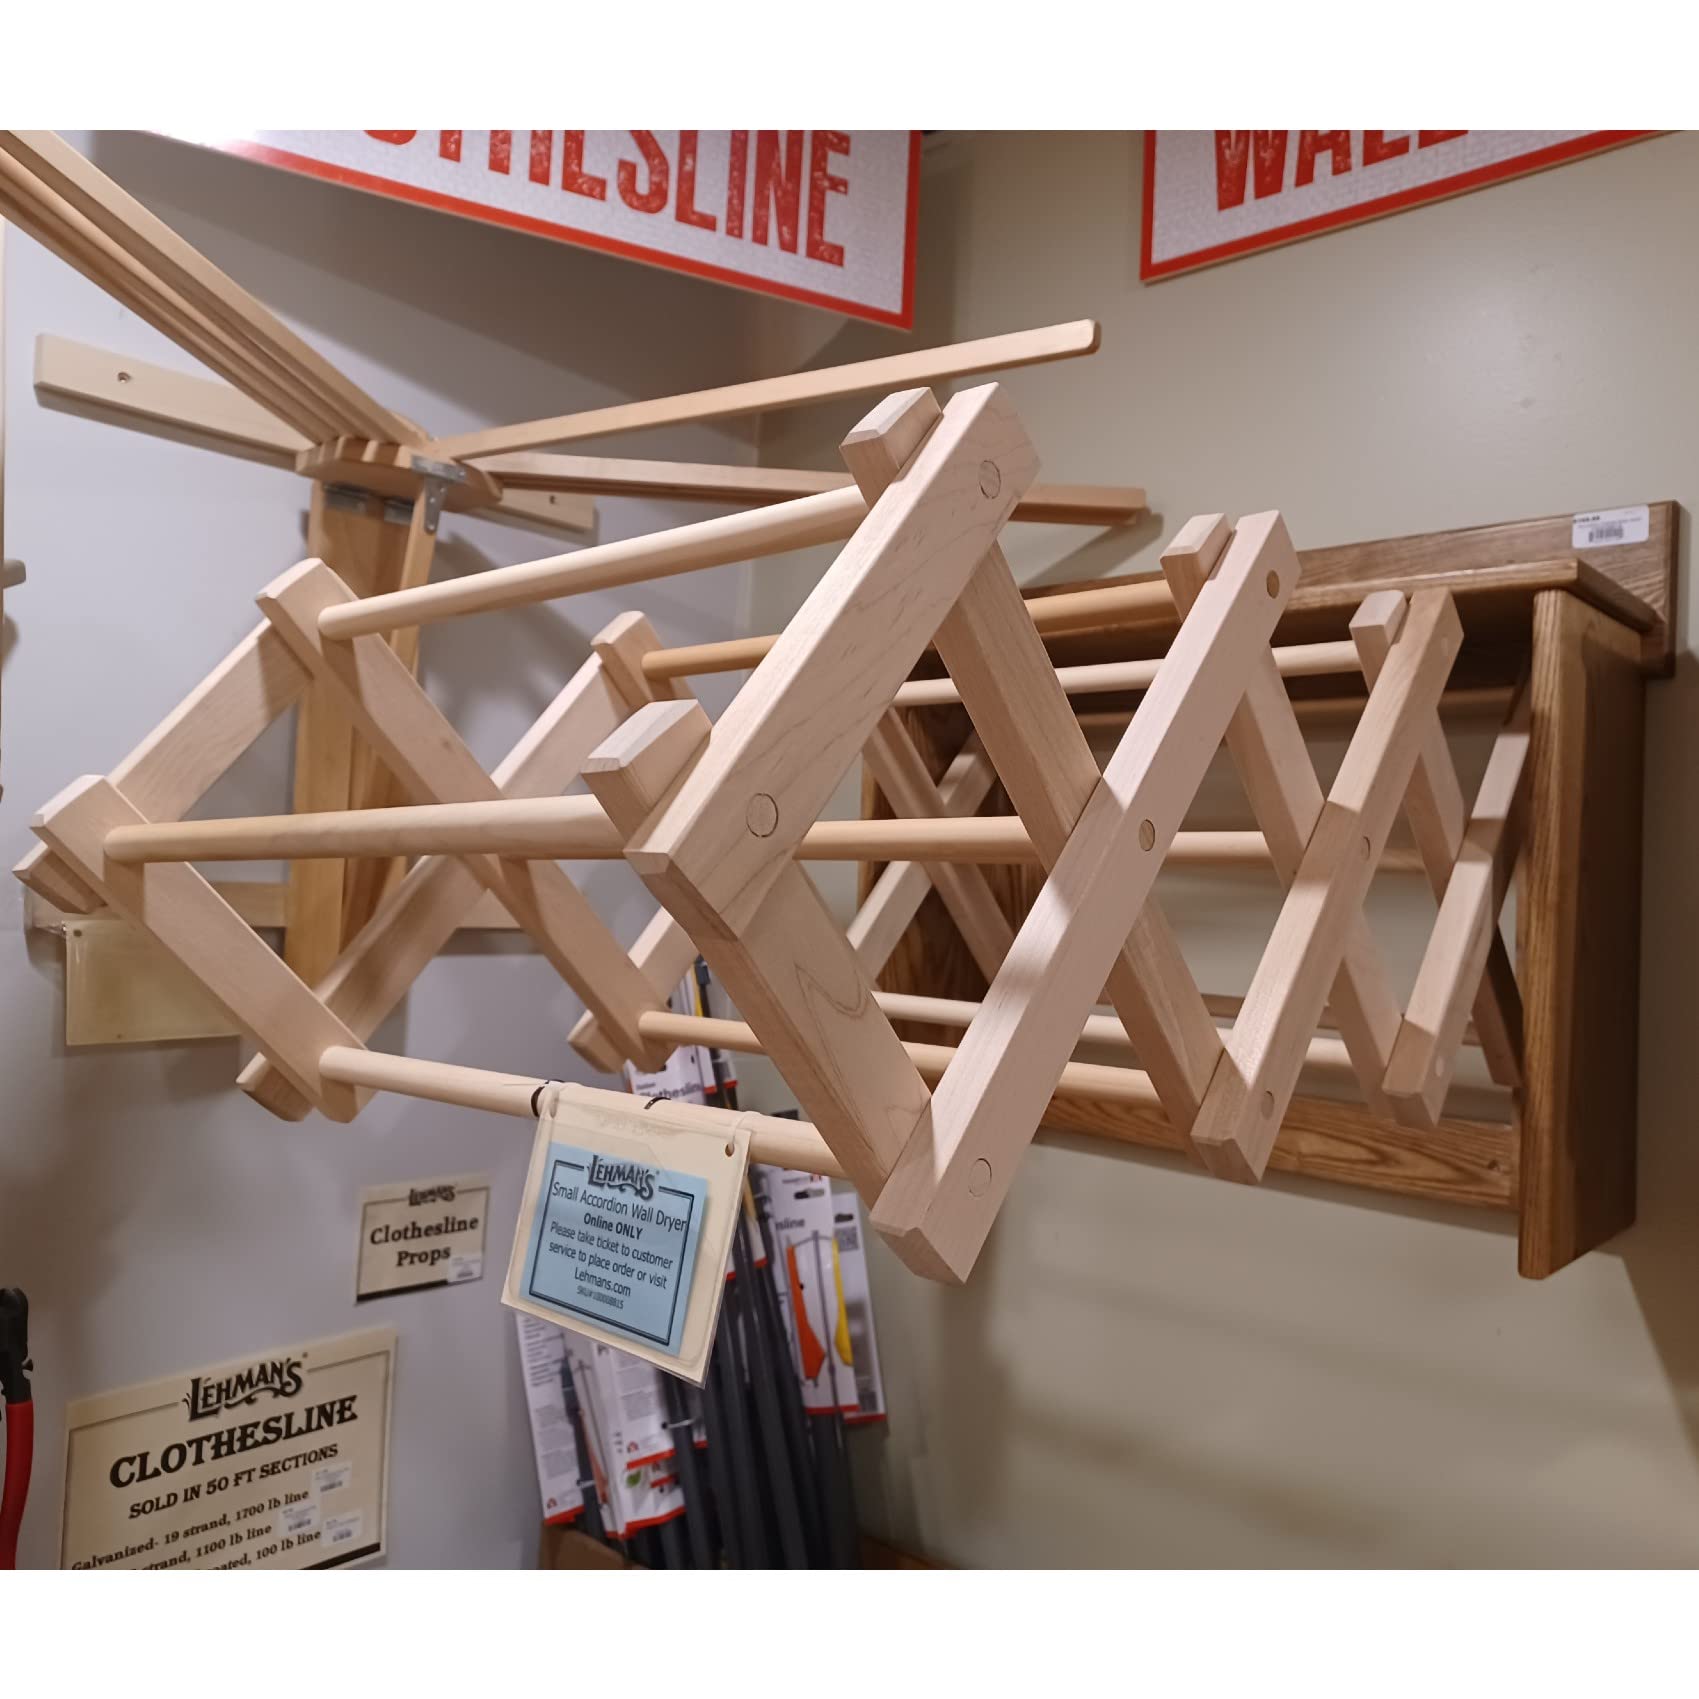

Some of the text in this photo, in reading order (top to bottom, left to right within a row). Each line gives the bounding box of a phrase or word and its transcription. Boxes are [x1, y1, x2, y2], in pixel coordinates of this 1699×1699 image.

[362, 130, 851, 267] SLINE
[587, 1155, 656, 1200] LEHMAN'S
[370, 1216, 479, 1245] Clothesline
[552, 1181, 687, 1232] Small Accordion Wall Dryer
[584, 1212, 643, 1240] Online ONLY
[396, 1246, 451, 1267] Props
[549, 1241, 667, 1289] service to place order or visit
[550, 1221, 673, 1269] Please take ticket to customer
[575, 1266, 631, 1297] Lehmans.com
[182, 1358, 303, 1421] LEHMAN'S
[109, 1395, 358, 1488] CLOTHESLINE
[128, 1492, 178, 1519] SOLD
[182, 1484, 202, 1503] IN
[206, 1476, 229, 1495] 50
[233, 1468, 256, 1487] FT
[258, 1443, 339, 1479] SECTIONS
[164, 1531, 180, 1545] 19
[182, 1513, 231, 1539] strand,
[236, 1503, 265, 1521] 1700
[268, 1497, 281, 1510] lb
[284, 1491, 309, 1505] line
[196, 1539, 226, 1557] 1100
[229, 1533, 243, 1547] lb
[246, 1525, 272, 1540] line
[208, 1530, 321, 1570] ated, 100 lb line
